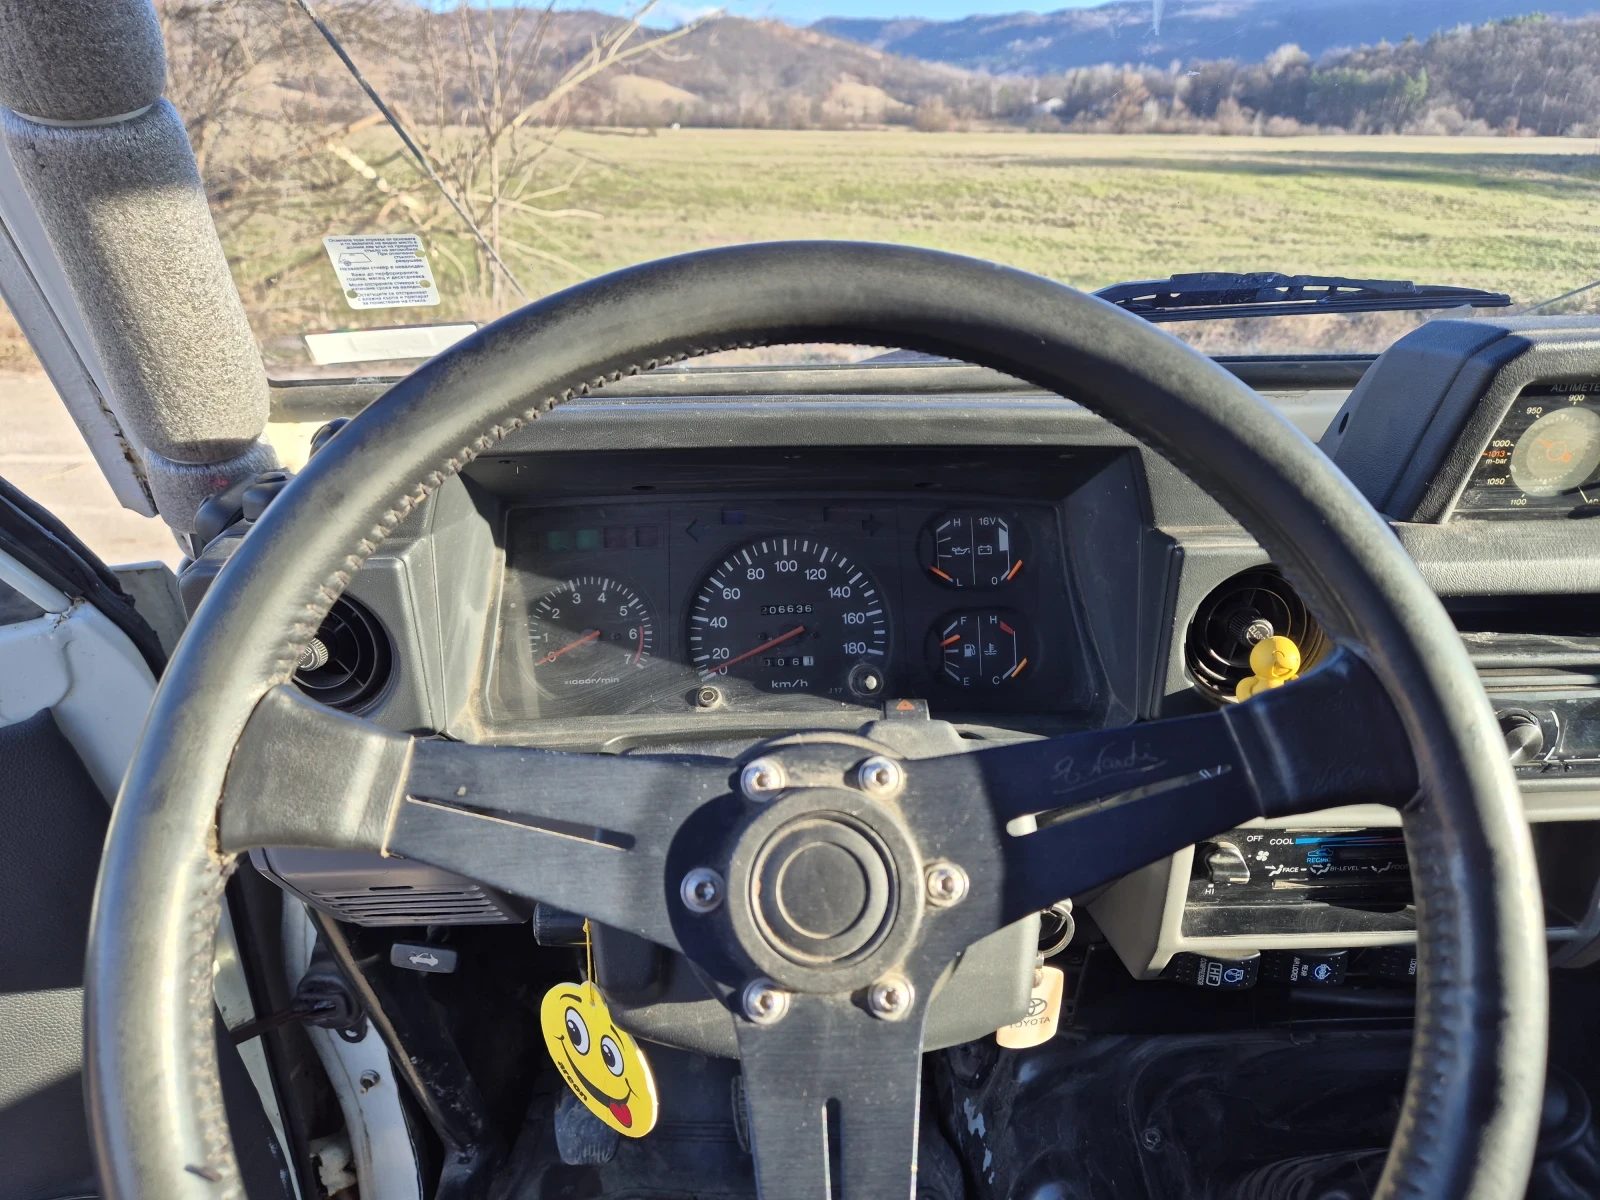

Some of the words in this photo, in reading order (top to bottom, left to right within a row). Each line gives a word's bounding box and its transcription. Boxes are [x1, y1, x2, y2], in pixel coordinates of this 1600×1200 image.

[1551, 383, 1600, 392] ALTIMETE
[978, 517, 996, 526] 16V
[775, 560, 797, 573] 100
[747, 568, 765, 580] 80
[804, 568, 827, 581] 120
[572, 592, 581, 605] 3
[597, 591, 607, 603] 4
[722, 587, 740, 600] 60
[828, 586, 851, 599] 140
[551, 607, 560, 619] 2
[619, 605, 628, 617] 5
[709, 616, 728, 629] 40
[842, 612, 865, 625] 160
[989, 616, 997, 624] H
[543, 632, 549, 643] 1
[629, 628, 638, 640] 6
[712, 647, 730, 660] 20
[843, 641, 866, 655] 180
[624, 653, 631, 664] 7
[719, 665, 728, 675] 0
[771, 678, 808, 689] km/h
[963, 677, 970, 685] E
[1197, 958, 1207, 985] COMPRESSOR
[1210, 967, 1220, 981] HF
[557, 1061, 587, 1101] areon
